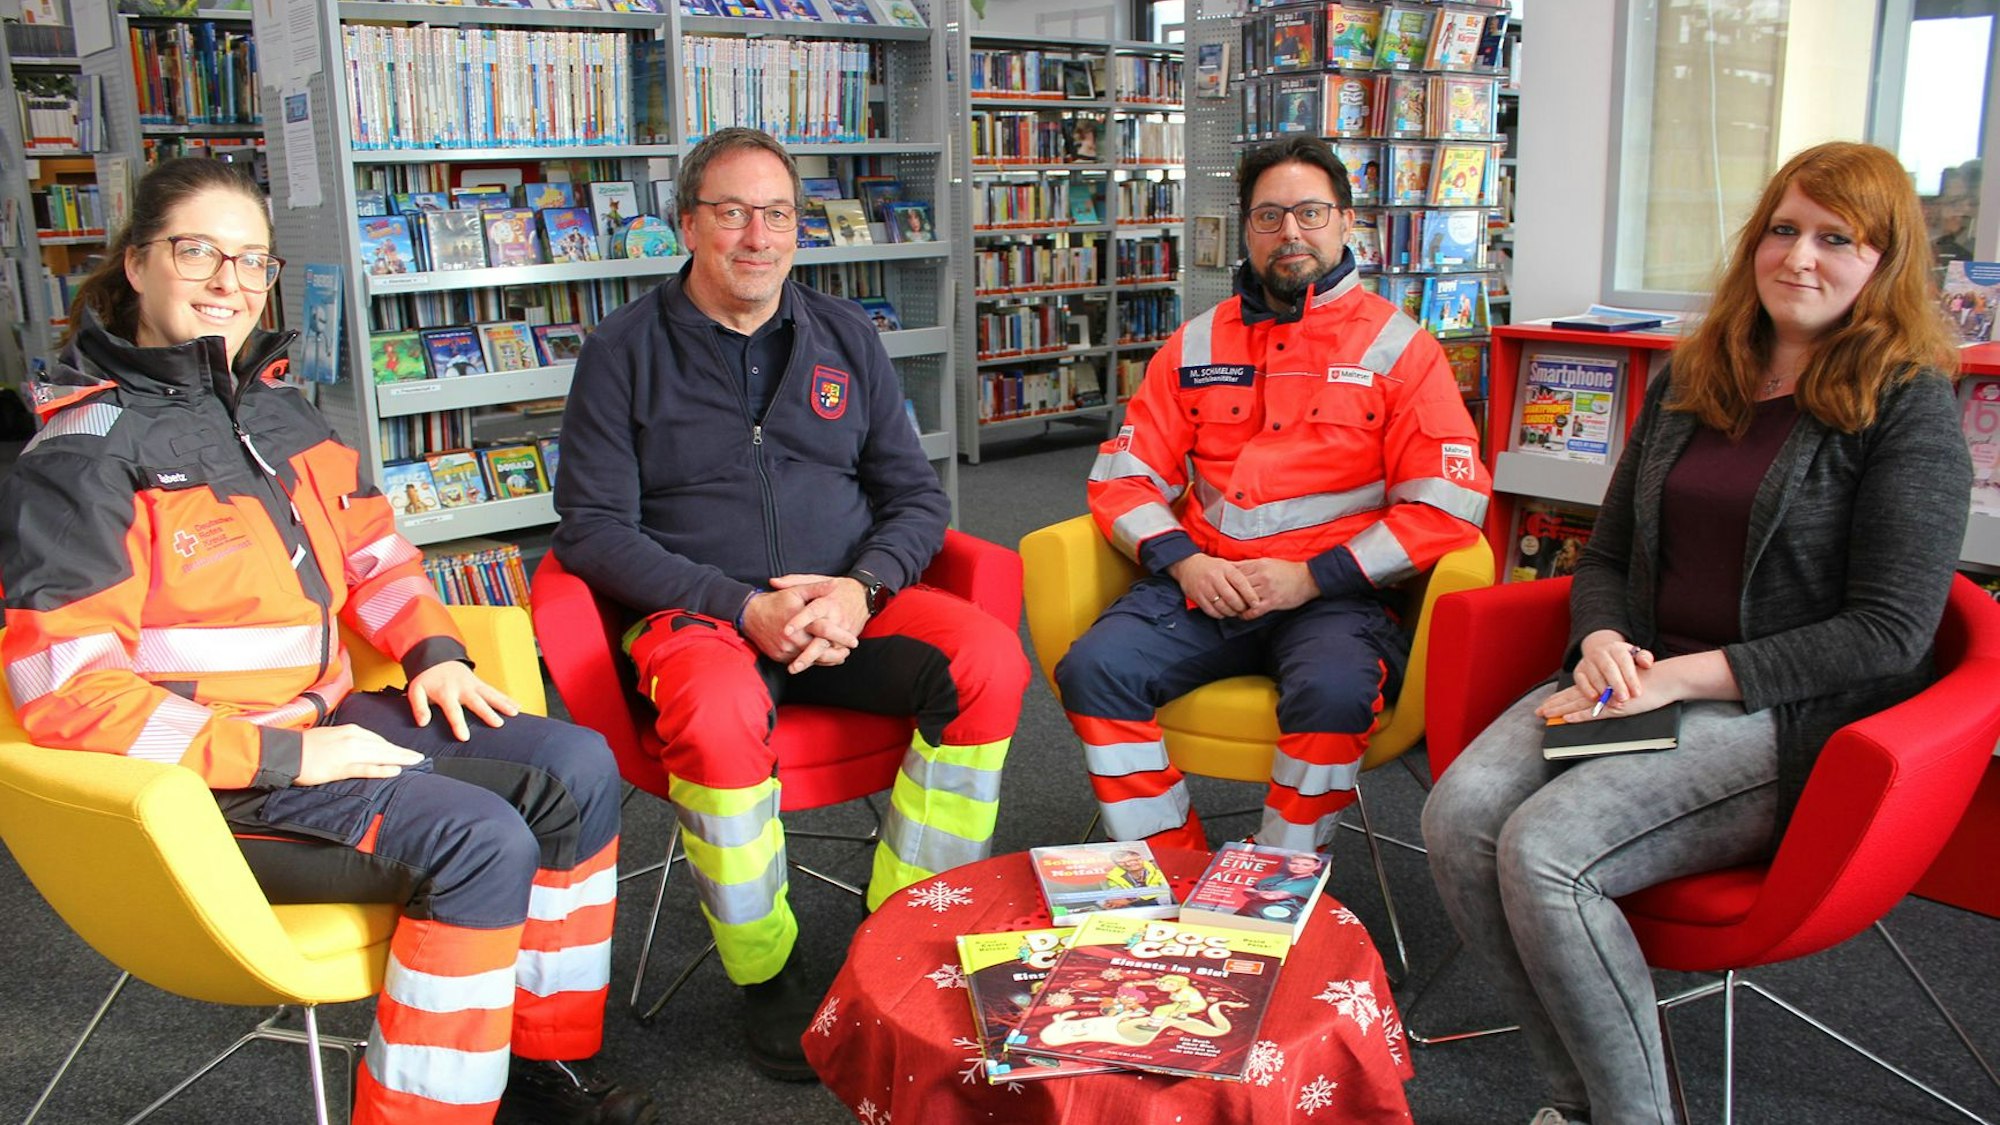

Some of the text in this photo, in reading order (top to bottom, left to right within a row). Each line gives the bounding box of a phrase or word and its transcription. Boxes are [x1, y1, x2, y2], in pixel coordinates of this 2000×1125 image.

[358, 201, 376, 216] idi
[1189, 367, 1244, 378] M. SCHMELING
[1341, 370, 1370, 379] Malteser
[1529, 362, 1614, 388] Smartphone
[496, 460, 535, 473] DONALD
[1220, 858, 1268, 873] EINE
[1208, 871, 1259, 887] ALLE
[1144, 923, 1230, 946] Doc
[1131, 941, 1232, 960] Caro
[1110, 957, 1230, 979] Einsatz im Blut
[1012, 972, 1050, 982] Eins
